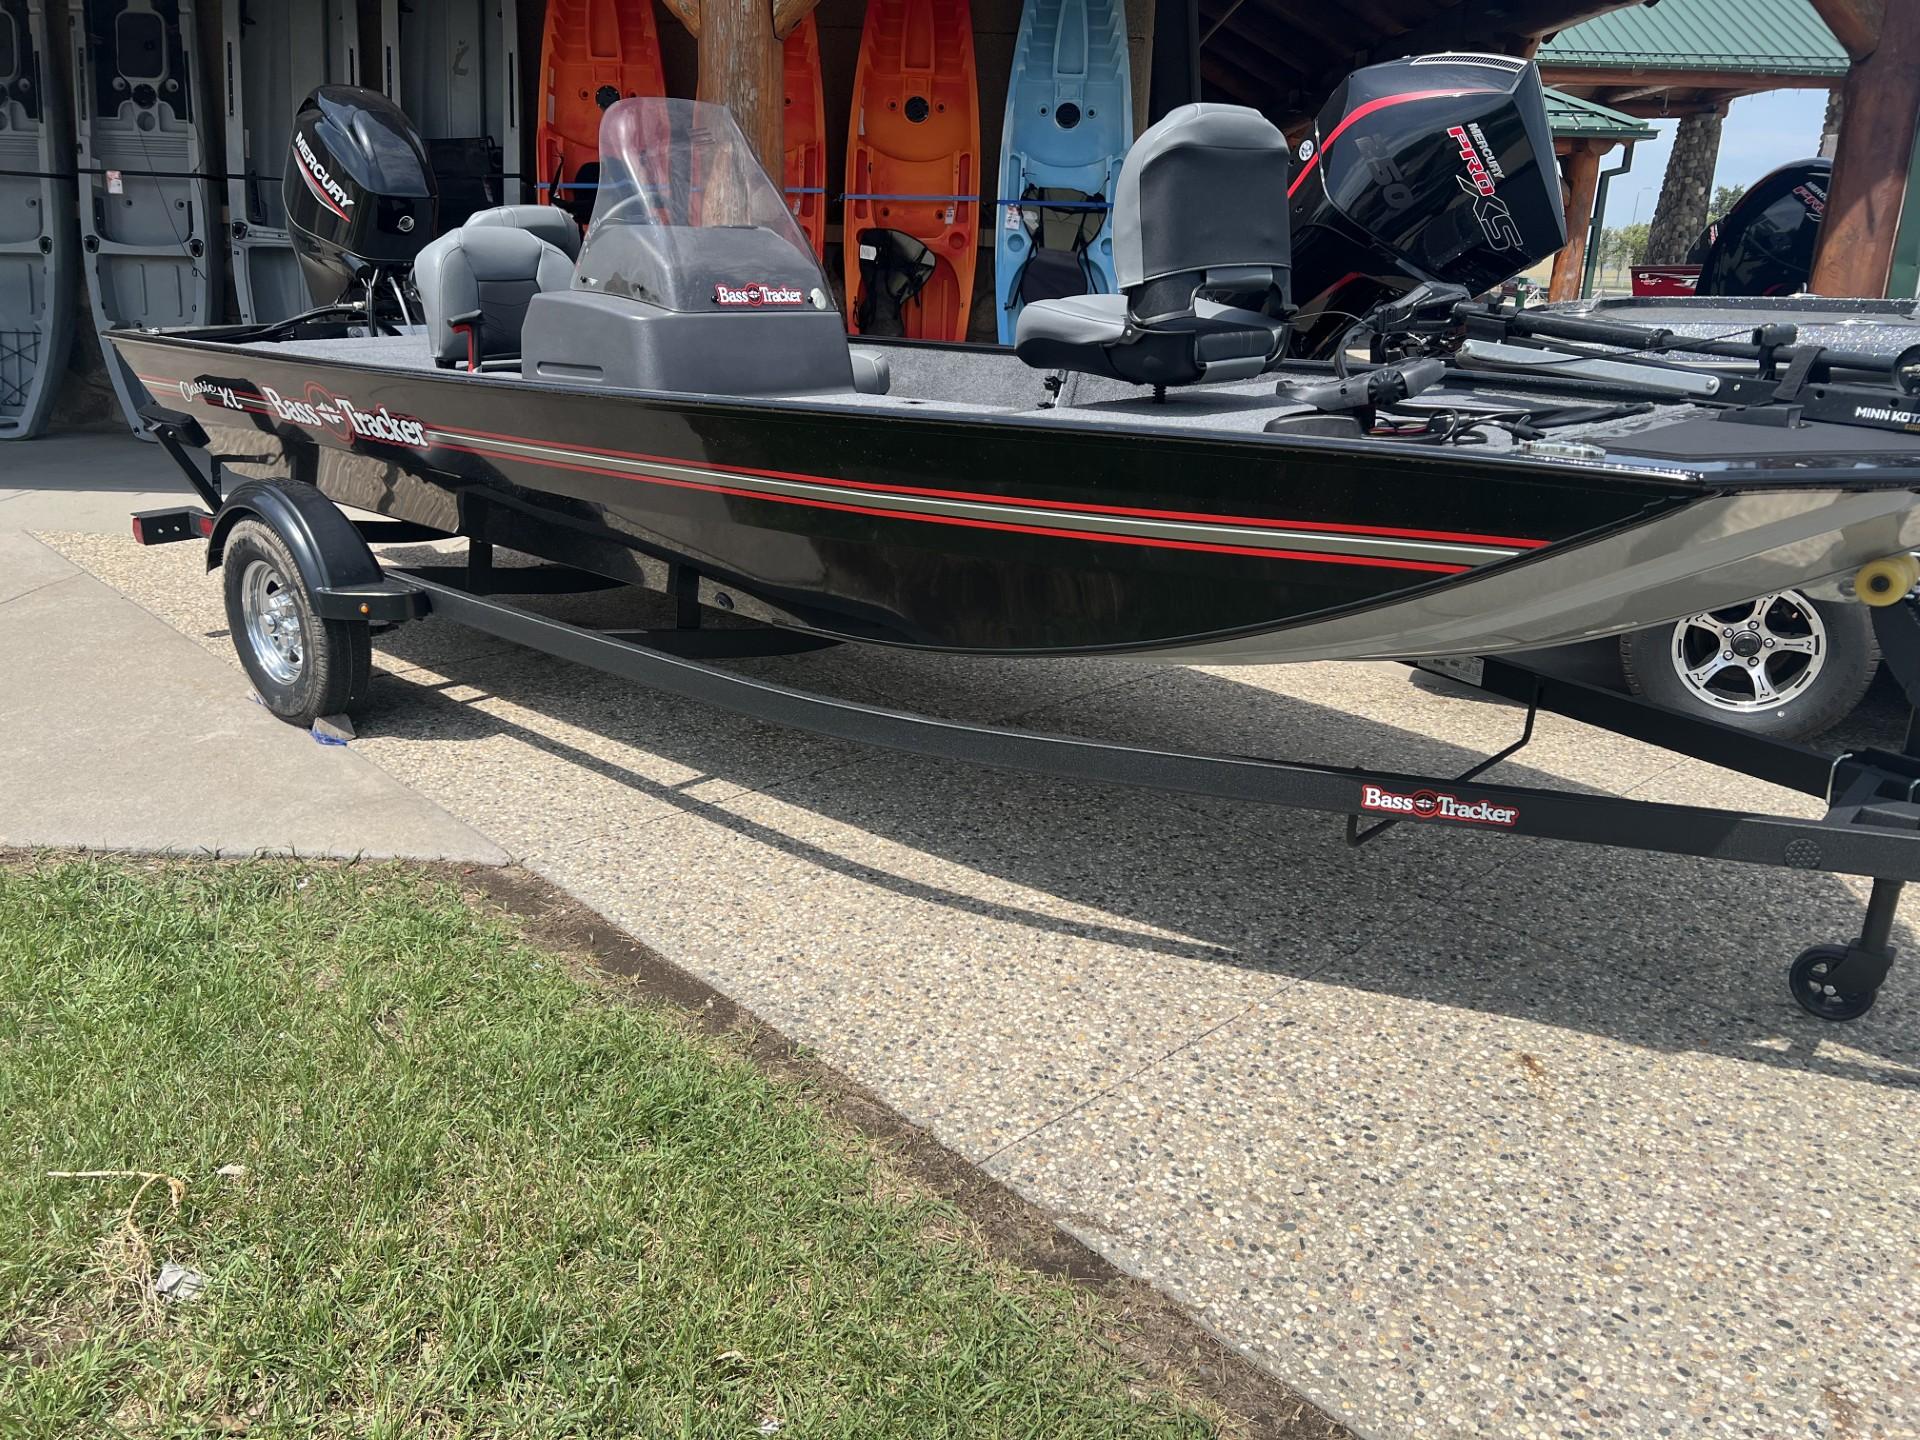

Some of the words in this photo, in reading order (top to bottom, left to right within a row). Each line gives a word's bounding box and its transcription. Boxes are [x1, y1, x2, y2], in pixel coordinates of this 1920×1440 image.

[295, 130, 355, 208] MERCURY
[1446, 125, 1496, 197] PRO
[1467, 122, 1506, 179] MERCURY
[1455, 169, 1523, 251] XS
[1805, 181, 1826, 201] MERC
[717, 285, 749, 303] Bass
[758, 285, 802, 303] Tracker
[180, 380, 217, 402] Classic
[1855, 406, 1891, 421] MINN
[262, 386, 323, 426] Bass
[335, 398, 429, 447] Tracker
[1364, 787, 1414, 811] Bass
[1437, 795, 1516, 824] Tracker
